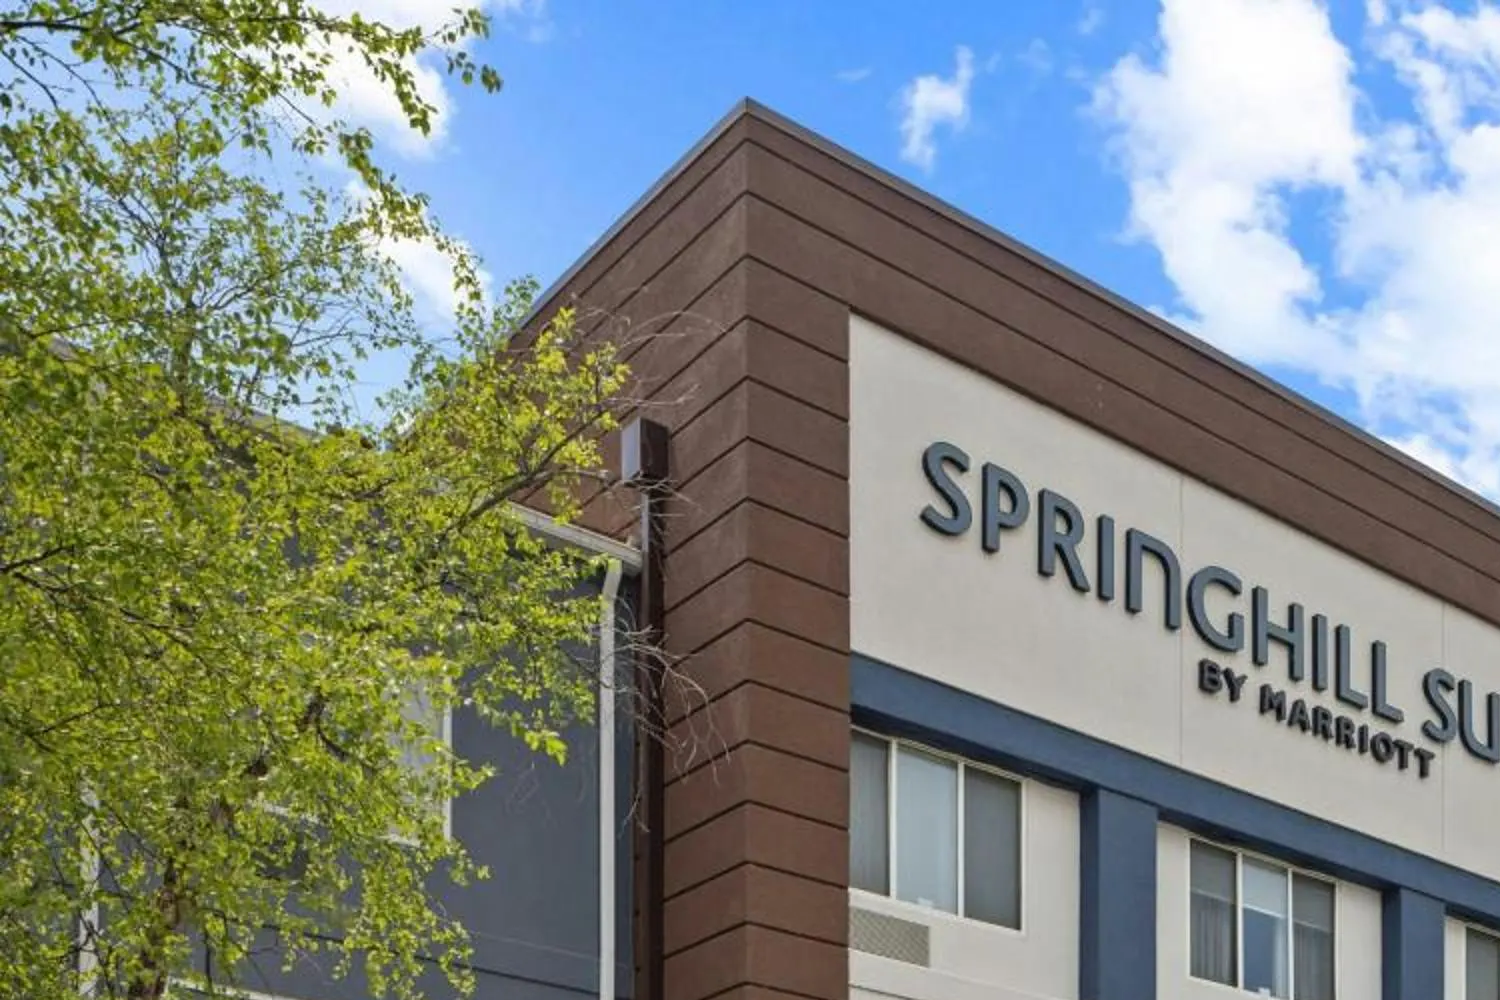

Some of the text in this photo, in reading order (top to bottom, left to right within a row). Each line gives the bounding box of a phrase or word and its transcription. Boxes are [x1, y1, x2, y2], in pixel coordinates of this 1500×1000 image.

[920, 441, 1404, 725] SPRINGHILL
[1198, 659, 1435, 779] BY MARRIOTT
